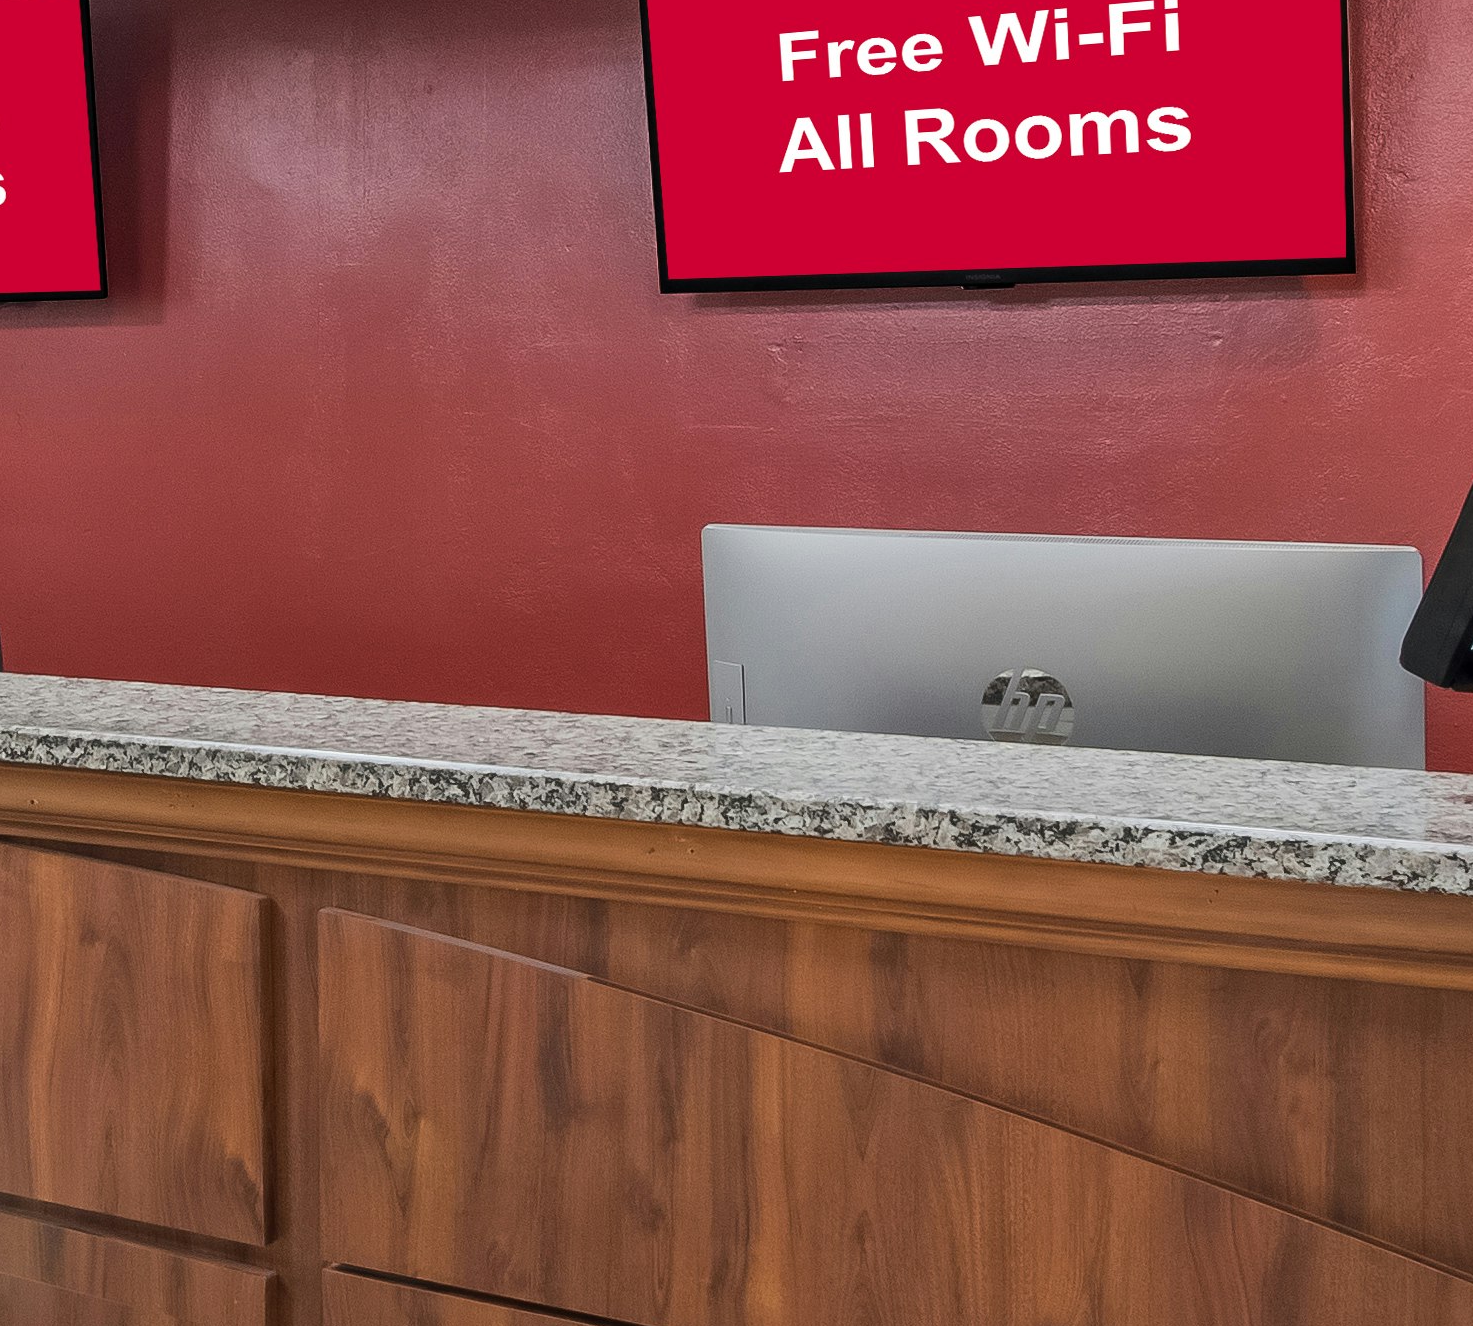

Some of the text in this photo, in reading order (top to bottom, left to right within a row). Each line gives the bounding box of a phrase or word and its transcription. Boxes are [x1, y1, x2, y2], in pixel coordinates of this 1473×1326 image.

[780, 30, 943, 81] Free
[780, 107, 1191, 172] All Rooms
[991, 667, 1066, 742] hp
